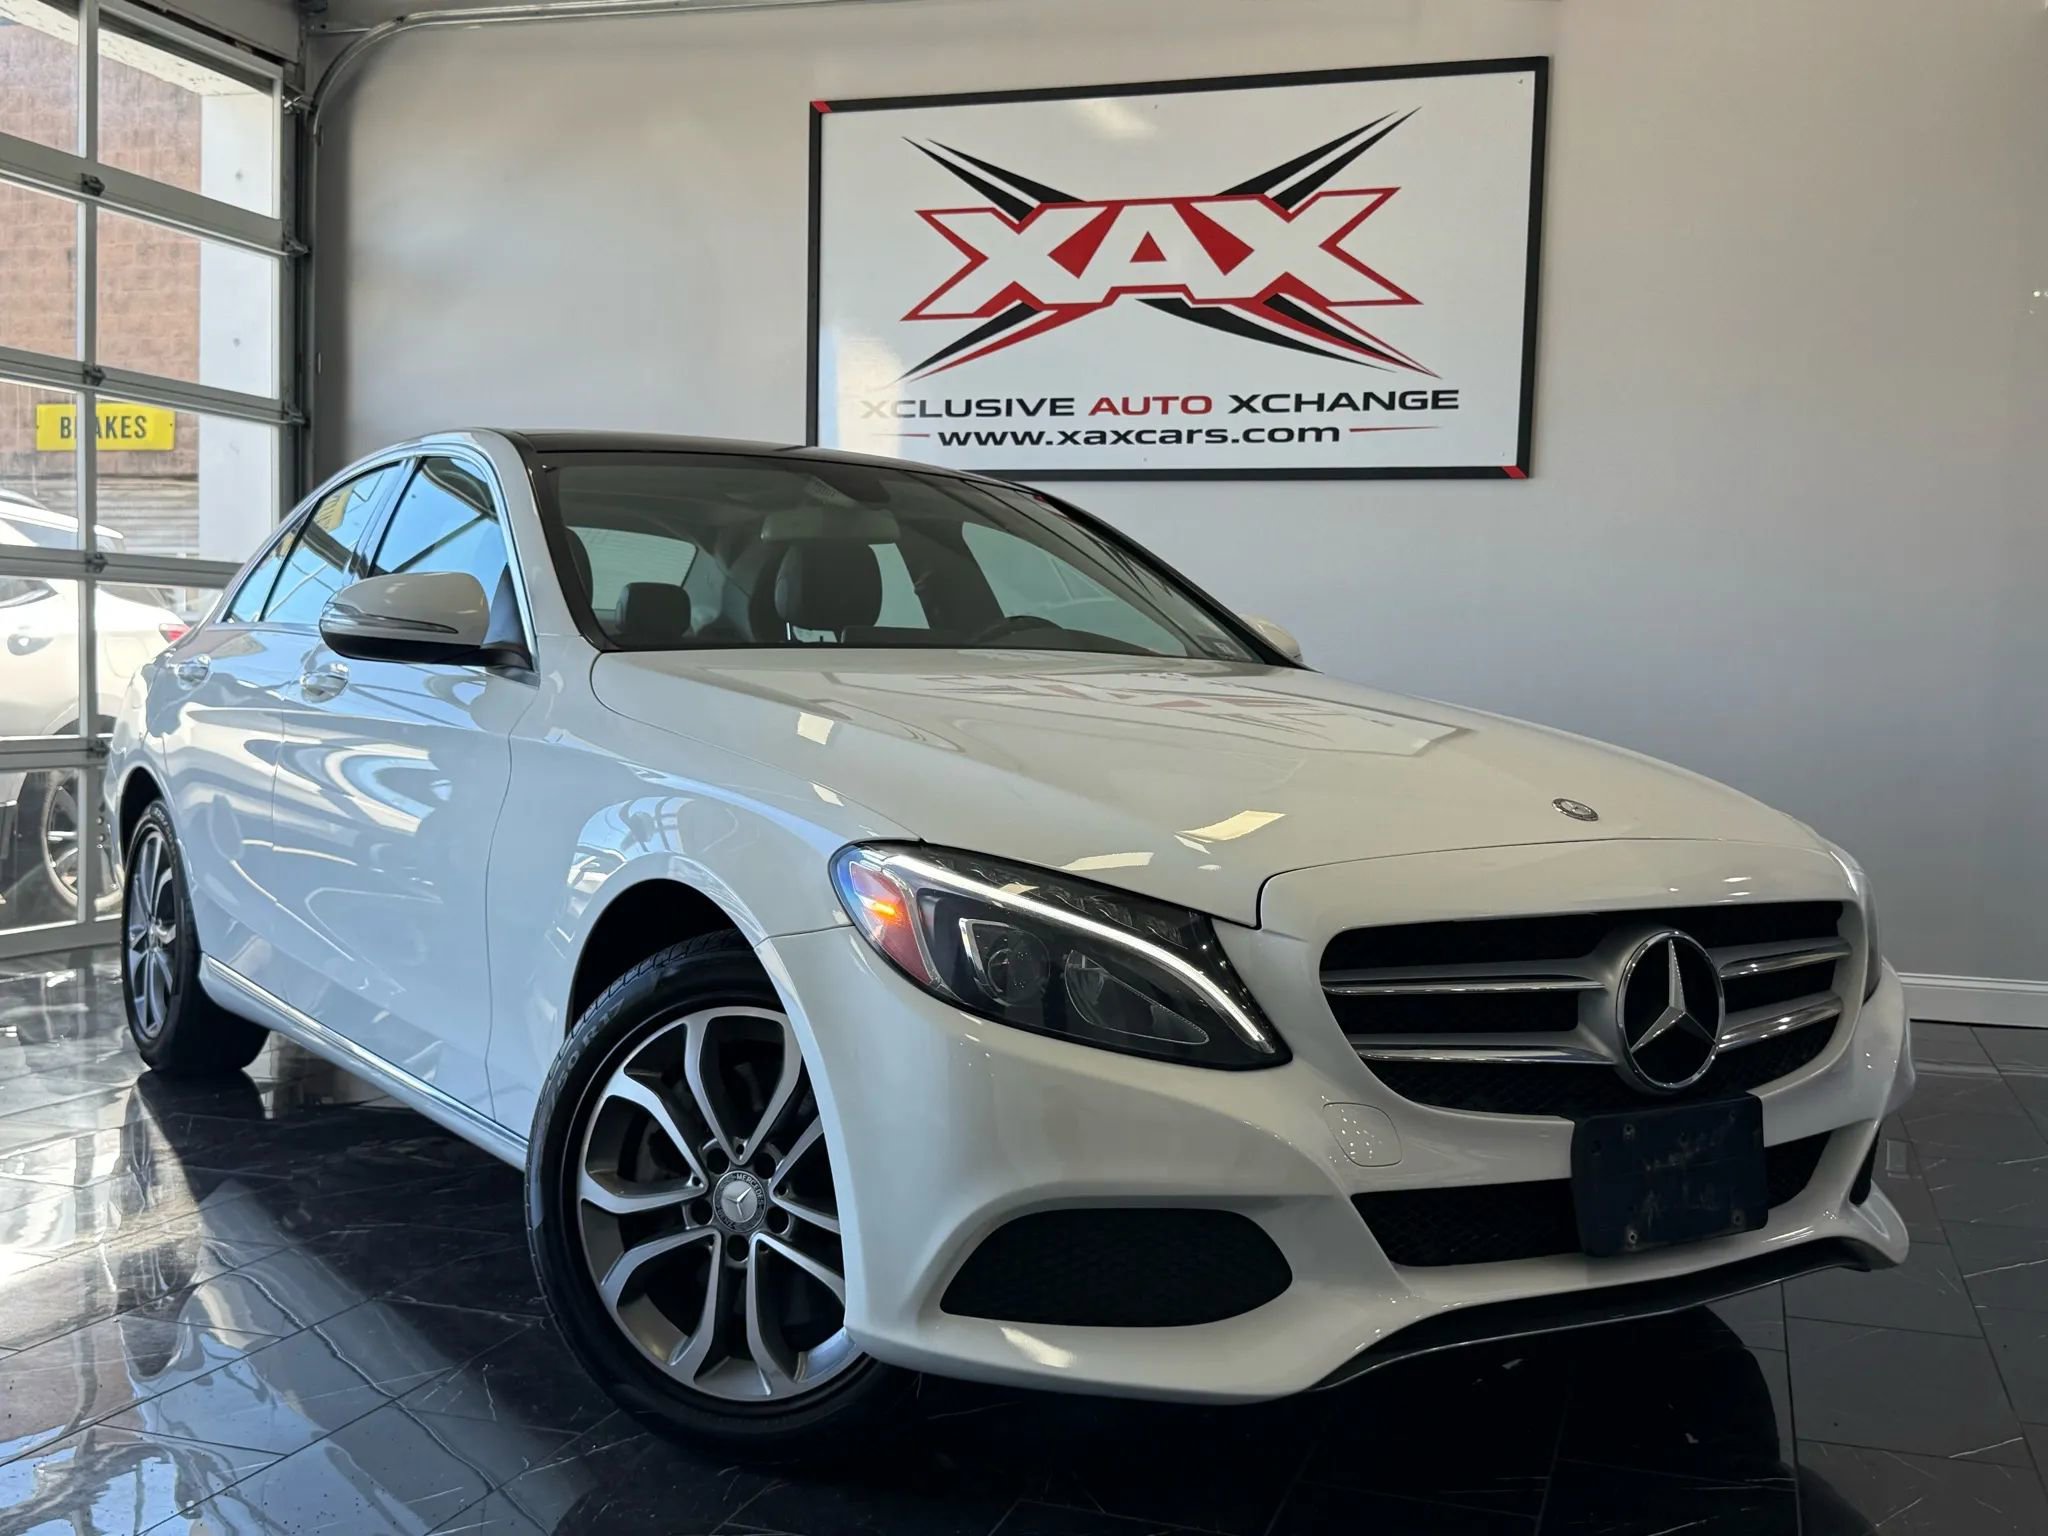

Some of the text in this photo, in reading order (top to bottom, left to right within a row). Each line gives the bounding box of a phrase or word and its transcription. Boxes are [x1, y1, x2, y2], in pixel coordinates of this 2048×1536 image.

[899, 186, 1424, 321] XAX
[861, 389, 1460, 418] XCLUSIVE AUTO XCHANGE
[60, 415, 147, 439] BAKES
[937, 425, 1341, 447] www.xaxcars.com
